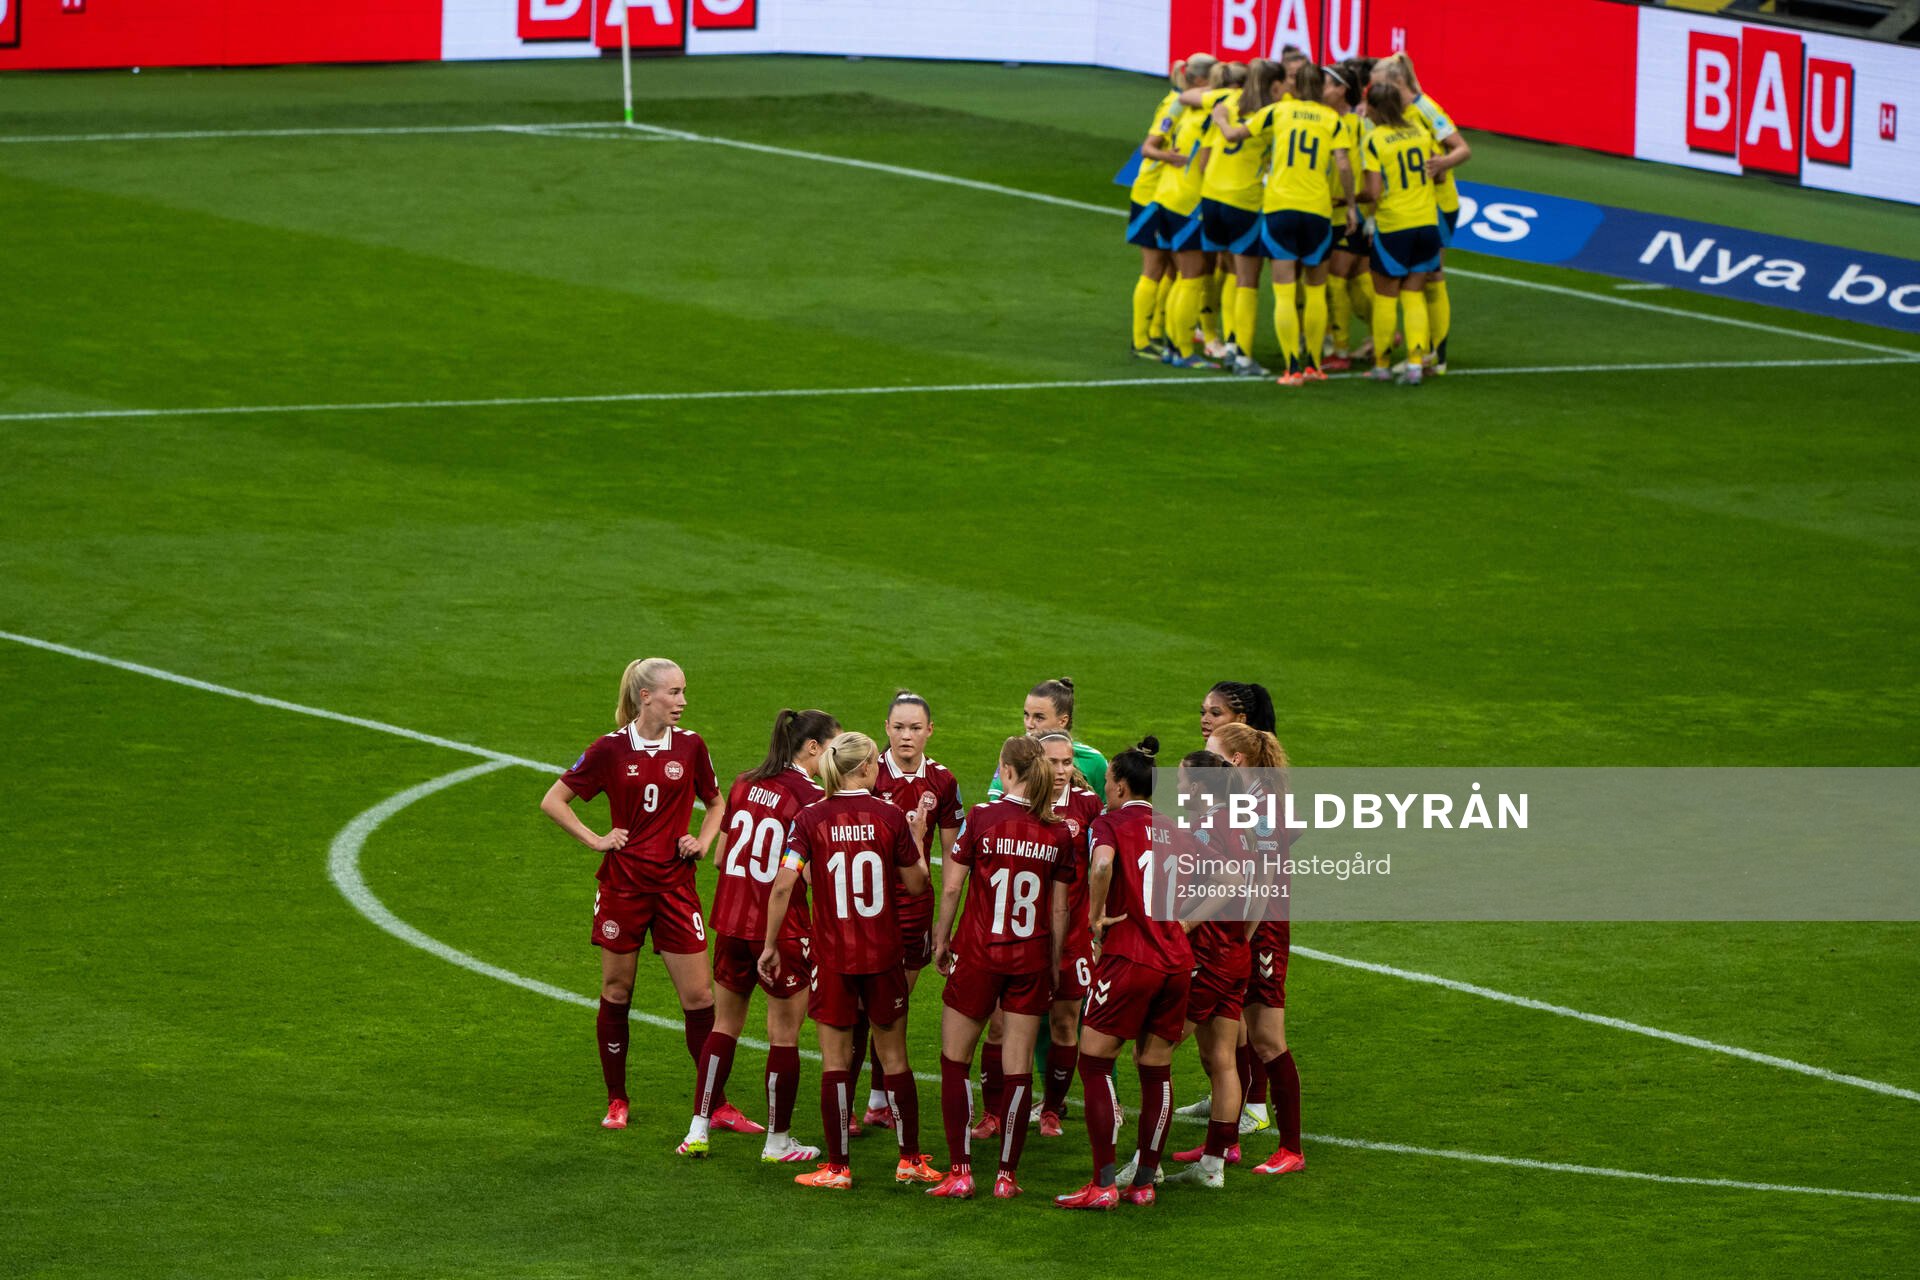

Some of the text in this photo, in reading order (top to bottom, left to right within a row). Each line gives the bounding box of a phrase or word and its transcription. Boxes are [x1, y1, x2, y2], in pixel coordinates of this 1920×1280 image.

[1694, 48, 1846, 151] BAU
[1287, 128, 1319, 170] 14
[1397, 147, 1426, 190] 19
[1638, 230, 1806, 292] Nya
[643, 783, 659, 812] 9
[748, 786, 781, 810] BRUUN
[725, 810, 785, 883] 20
[831, 824, 875, 842] HARDER
[982, 837, 1059, 863] S. HOLMGAARD
[1145, 825, 1171, 845] VEJE
[826, 850, 884, 918] 10
[990, 867, 1041, 938] 18
[1138, 850, 1178, 921] 11
[692, 911, 705, 941] 9
[1076, 957, 1091, 986] 6
